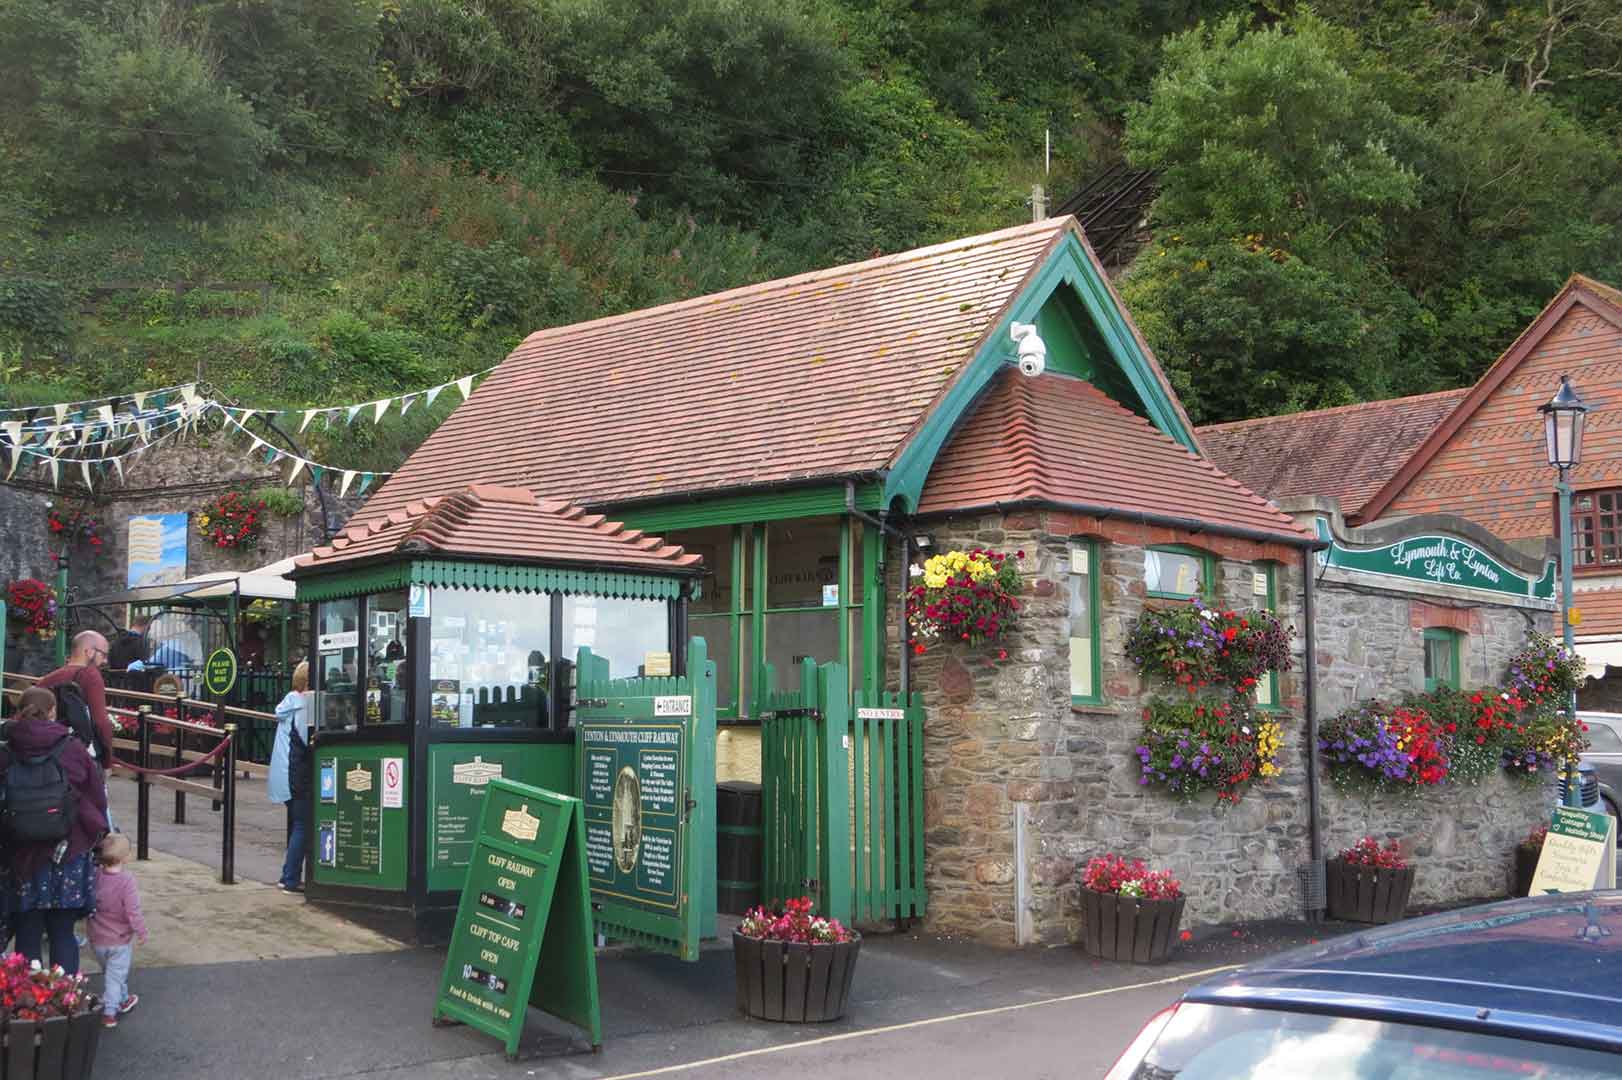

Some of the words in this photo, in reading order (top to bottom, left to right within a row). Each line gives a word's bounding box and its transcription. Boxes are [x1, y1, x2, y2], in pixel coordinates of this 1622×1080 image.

[1391, 538, 1447, 568] Lynmouth
[1450, 543, 1460, 560] &
[1462, 547, 1500, 583] Lynton
[1424, 559, 1445, 582] Lift
[663, 699, 689, 713] ENTRANCE
[638, 731, 653, 744] CLIFF
[653, 732, 679, 744] RAILWAY
[488, 854, 506, 868] CLIFF
[506, 859, 536, 878] RAILWAY
[497, 876, 517, 891] OPEN
[470, 923, 488, 939] CLIFF
[488, 930, 502, 945] TOP
[501, 935, 521, 952] CAFE
[480, 949, 499, 964] OPEN
[462, 964, 472, 980] 10
[488, 974, 497, 990] 5
[449, 985, 462, 996] Food
[466, 992, 482, 1006] Drink
[482, 999, 494, 1010] with
[498, 1008, 512, 1018] view
